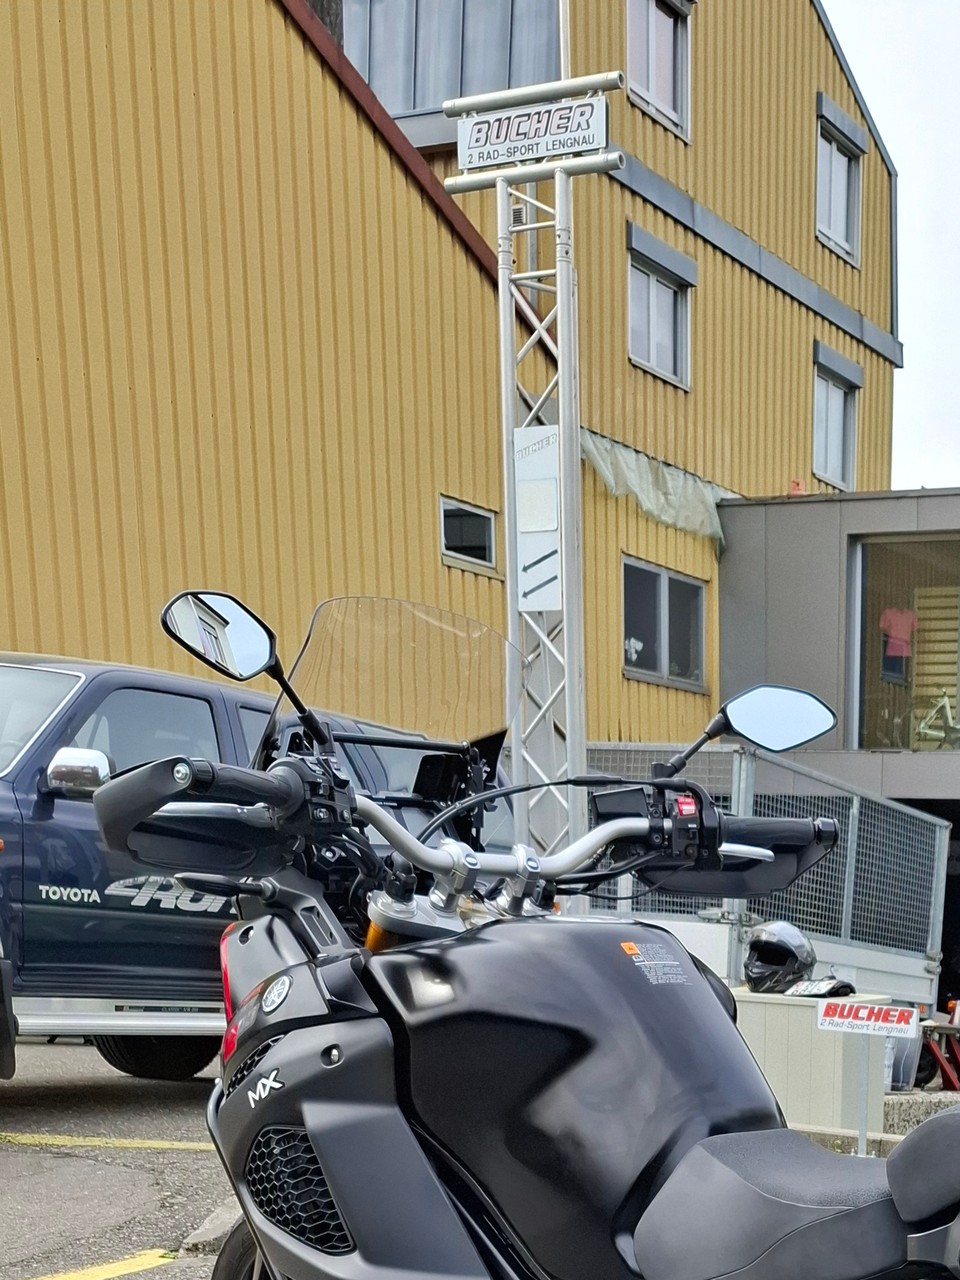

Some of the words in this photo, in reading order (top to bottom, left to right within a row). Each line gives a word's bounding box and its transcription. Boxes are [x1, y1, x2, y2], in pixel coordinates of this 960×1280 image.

[468, 102, 594, 149] BUCHER
[467, 153, 474, 164] 2
[477, 143, 541, 163] RAD-SPORT
[545, 133, 595, 152] LENGNAU
[39, 884, 101, 904] TOYOTA
[822, 1002, 914, 1026] BUCHER
[872, 1023, 909, 1035] Lengnau
[247, 1068, 284, 1109] MX
